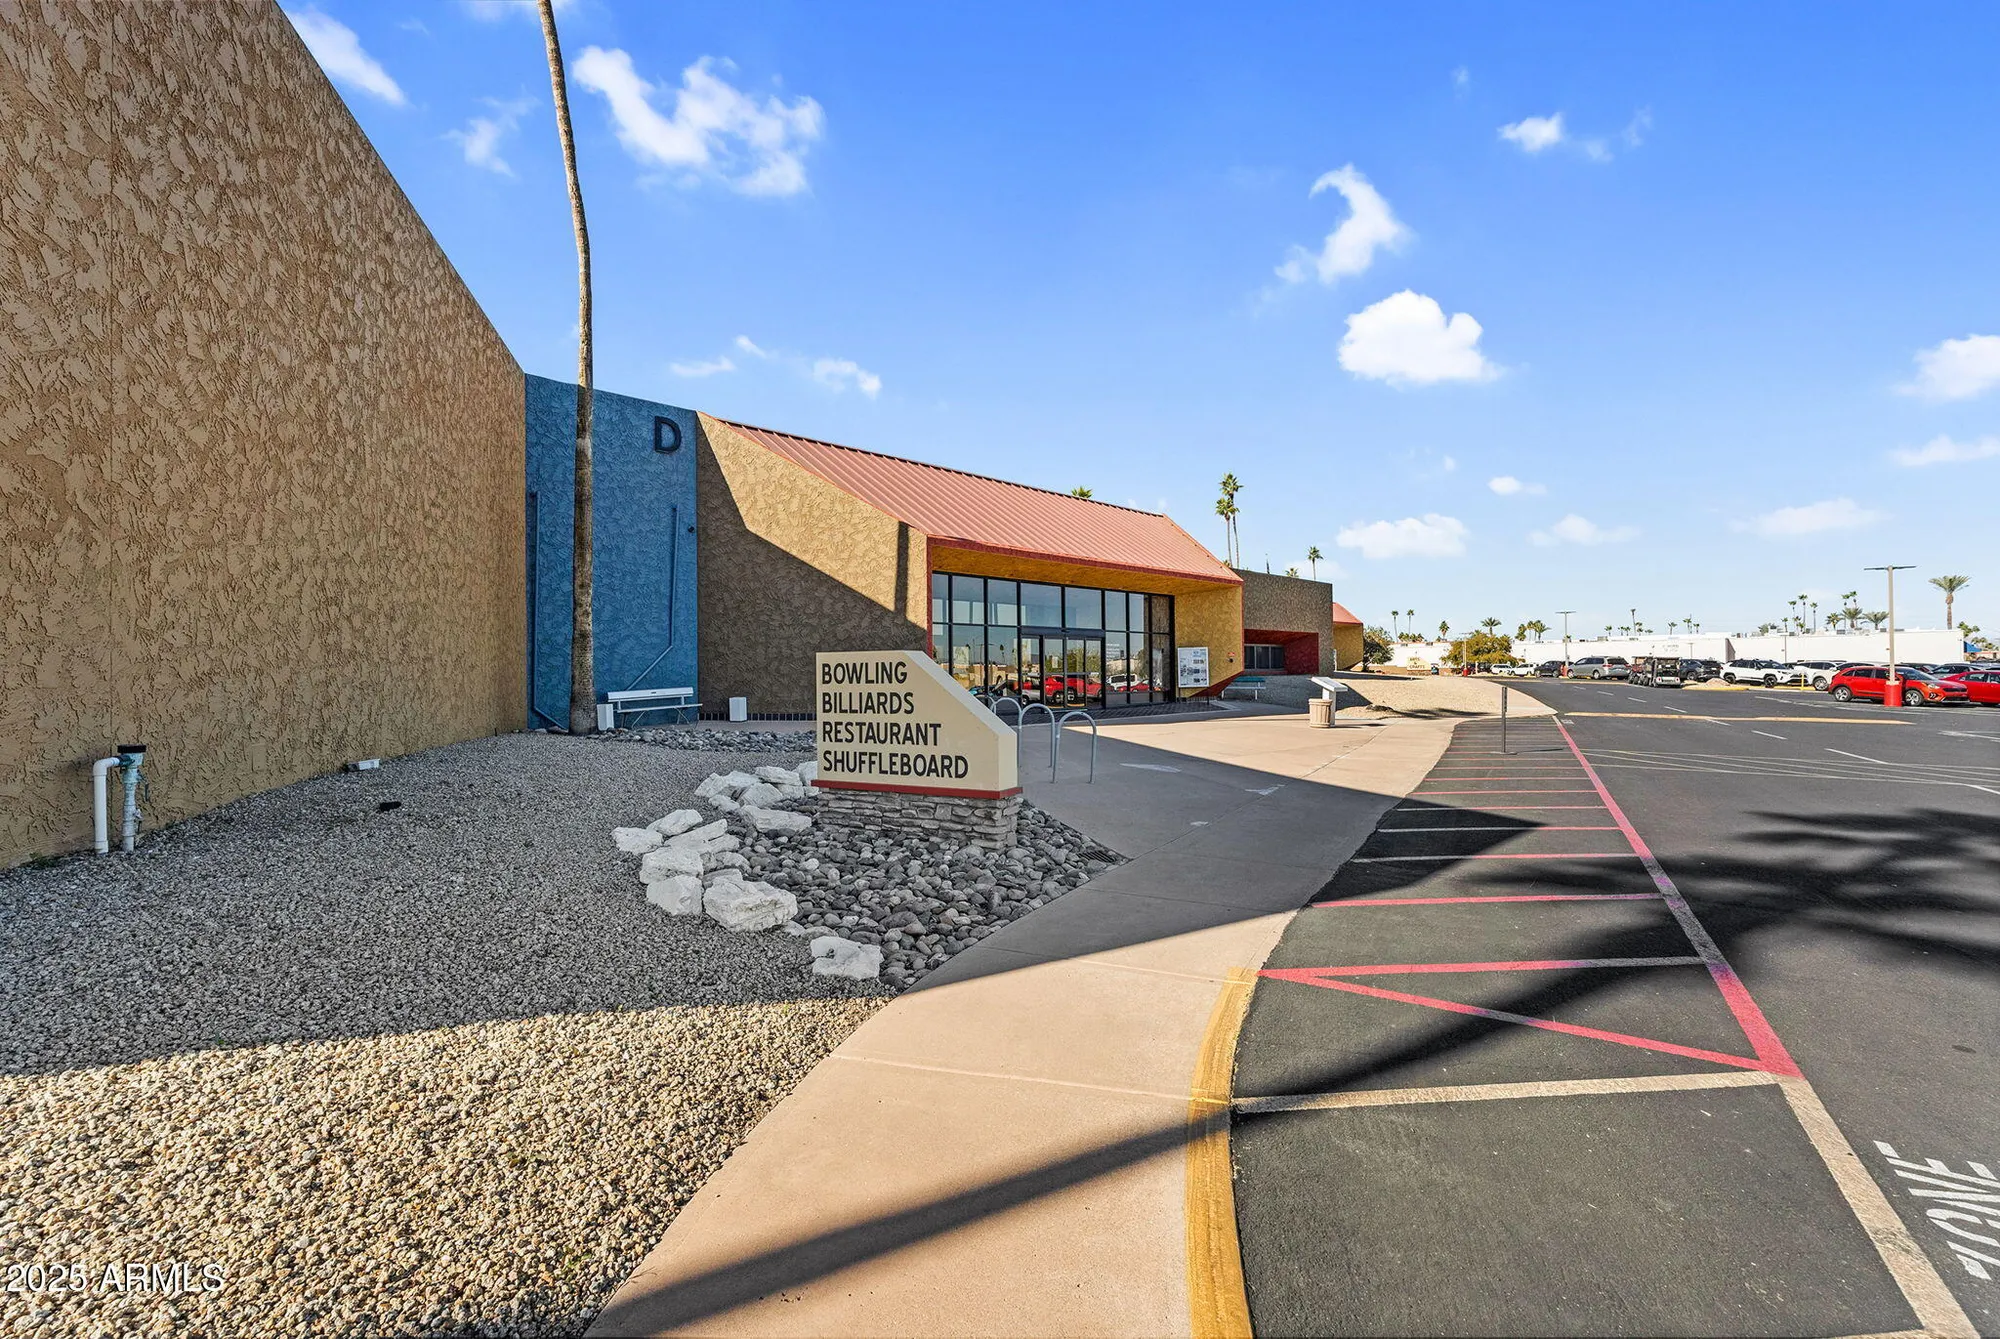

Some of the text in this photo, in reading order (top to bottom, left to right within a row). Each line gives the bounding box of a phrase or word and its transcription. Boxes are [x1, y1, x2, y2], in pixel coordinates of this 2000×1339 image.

[654, 416, 681, 454] D
[821, 661, 908, 685] BOWLING
[822, 692, 915, 715] BILLIARDS
[822, 721, 942, 747] RESTAURANT
[823, 750, 969, 779] SHUFFLEBOARD
